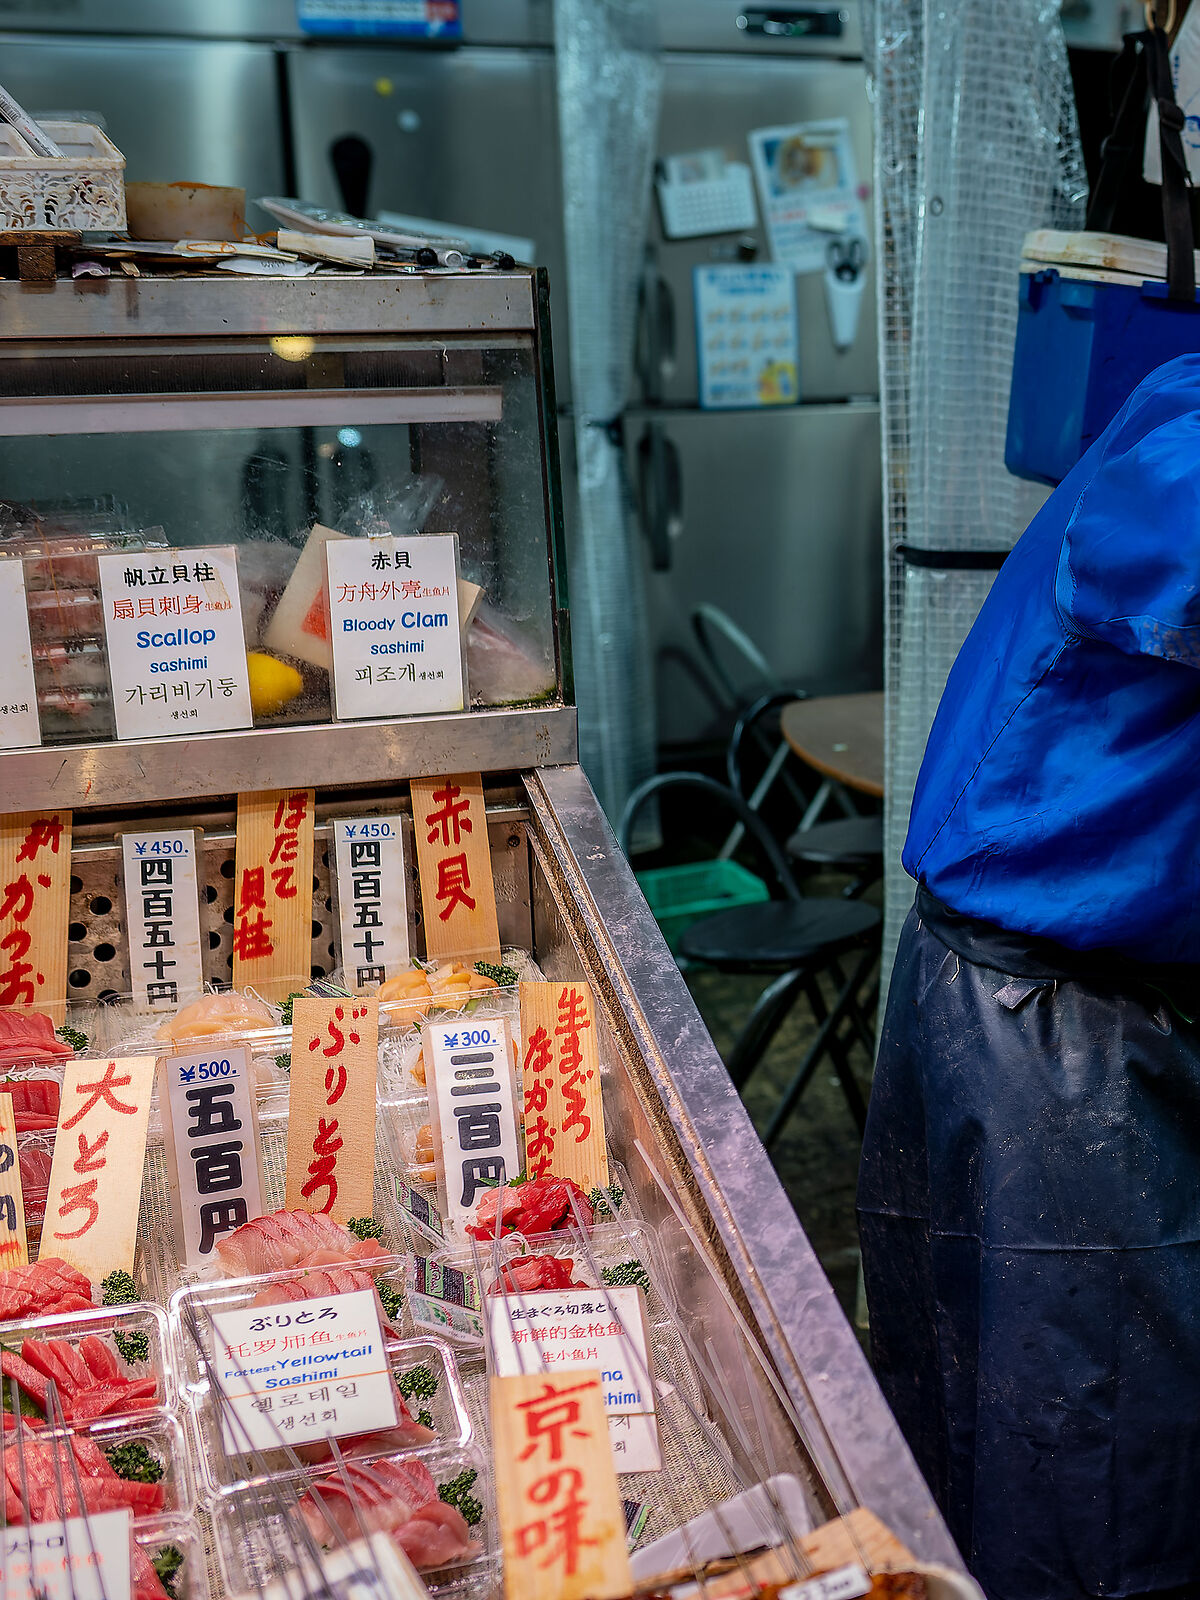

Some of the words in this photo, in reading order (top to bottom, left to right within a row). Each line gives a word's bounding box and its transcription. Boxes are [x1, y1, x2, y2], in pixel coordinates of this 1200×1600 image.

[124, 562, 215, 588] 帆立貝柱
[371, 551, 412, 570] 赤貝
[136, 628, 216, 649] Scallop
[343, 617, 396, 633] Bloody
[401, 611, 449, 629] Clam
[370, 639, 425, 656] sashimi
[150, 656, 209, 674] sashimi
[355, 663, 416, 686] 피조개
[125, 677, 239, 706] 가리비기둥
[268, 791, 309, 900] ほたて
[425, 781, 477, 923] 赤貝
[350, 840, 387, 989] 四百五十円
[140, 858, 178, 1006] 四百五十円
[554, 987, 591, 1143] 生まぐろ
[300, 1002, 368, 1215] ぶりとろ
[450, 1051, 506, 1208] 三百円
[54, 1061, 138, 1241] 大とろ
[185, 1084, 248, 1255] 五百円
[249, 1307, 338, 1332] ぶりとろ
[225, 1364, 277, 1379] Fattest
[276, 1345, 373, 1370] Yellowtail
[265, 1368, 338, 1389] Sashimi
[515, 1379, 602, 1578] 京の味
